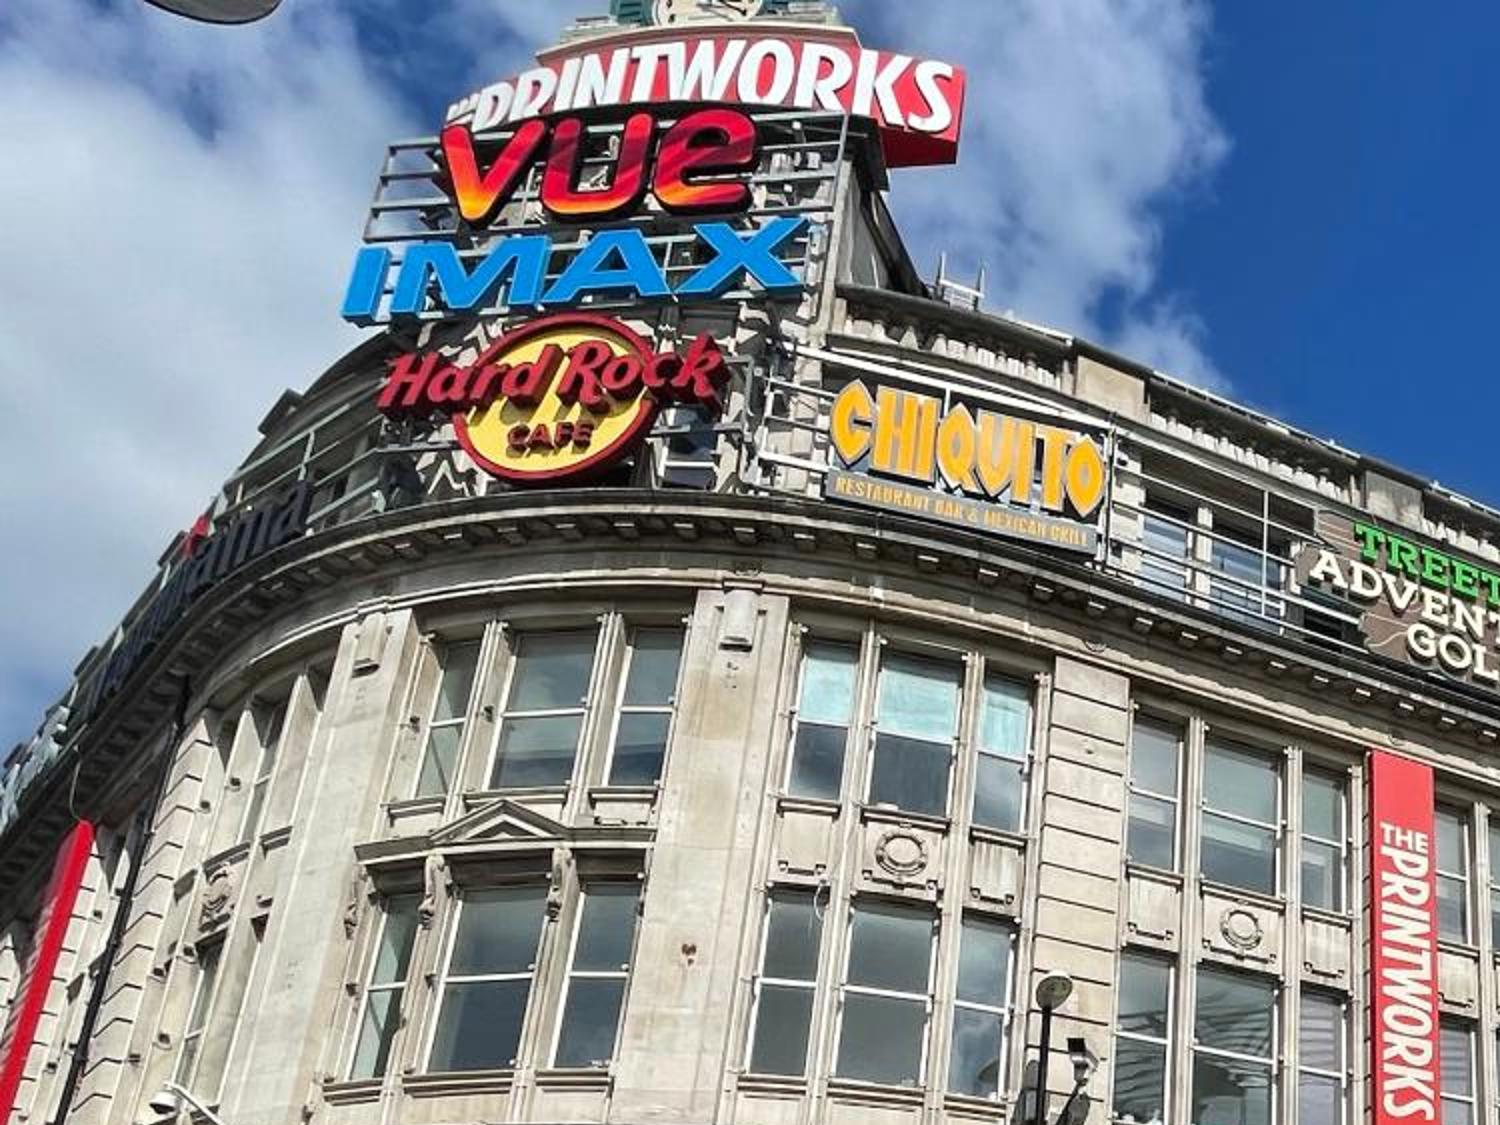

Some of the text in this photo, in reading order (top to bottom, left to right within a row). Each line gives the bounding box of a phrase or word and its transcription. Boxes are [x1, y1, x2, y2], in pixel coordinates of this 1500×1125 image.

[471, 38, 954, 133] PRINTWORKS
[341, 216, 810, 327] IMAX
[376, 331, 727, 414] Hard Rock
[507, 419, 594, 450] CAFE
[830, 378, 1106, 518] CHIQUITO
[835, 476, 929, 511] RESTAURANT
[1380, 821, 1429, 855] THE
[1380, 844, 1435, 1122] PRINTWORKS
